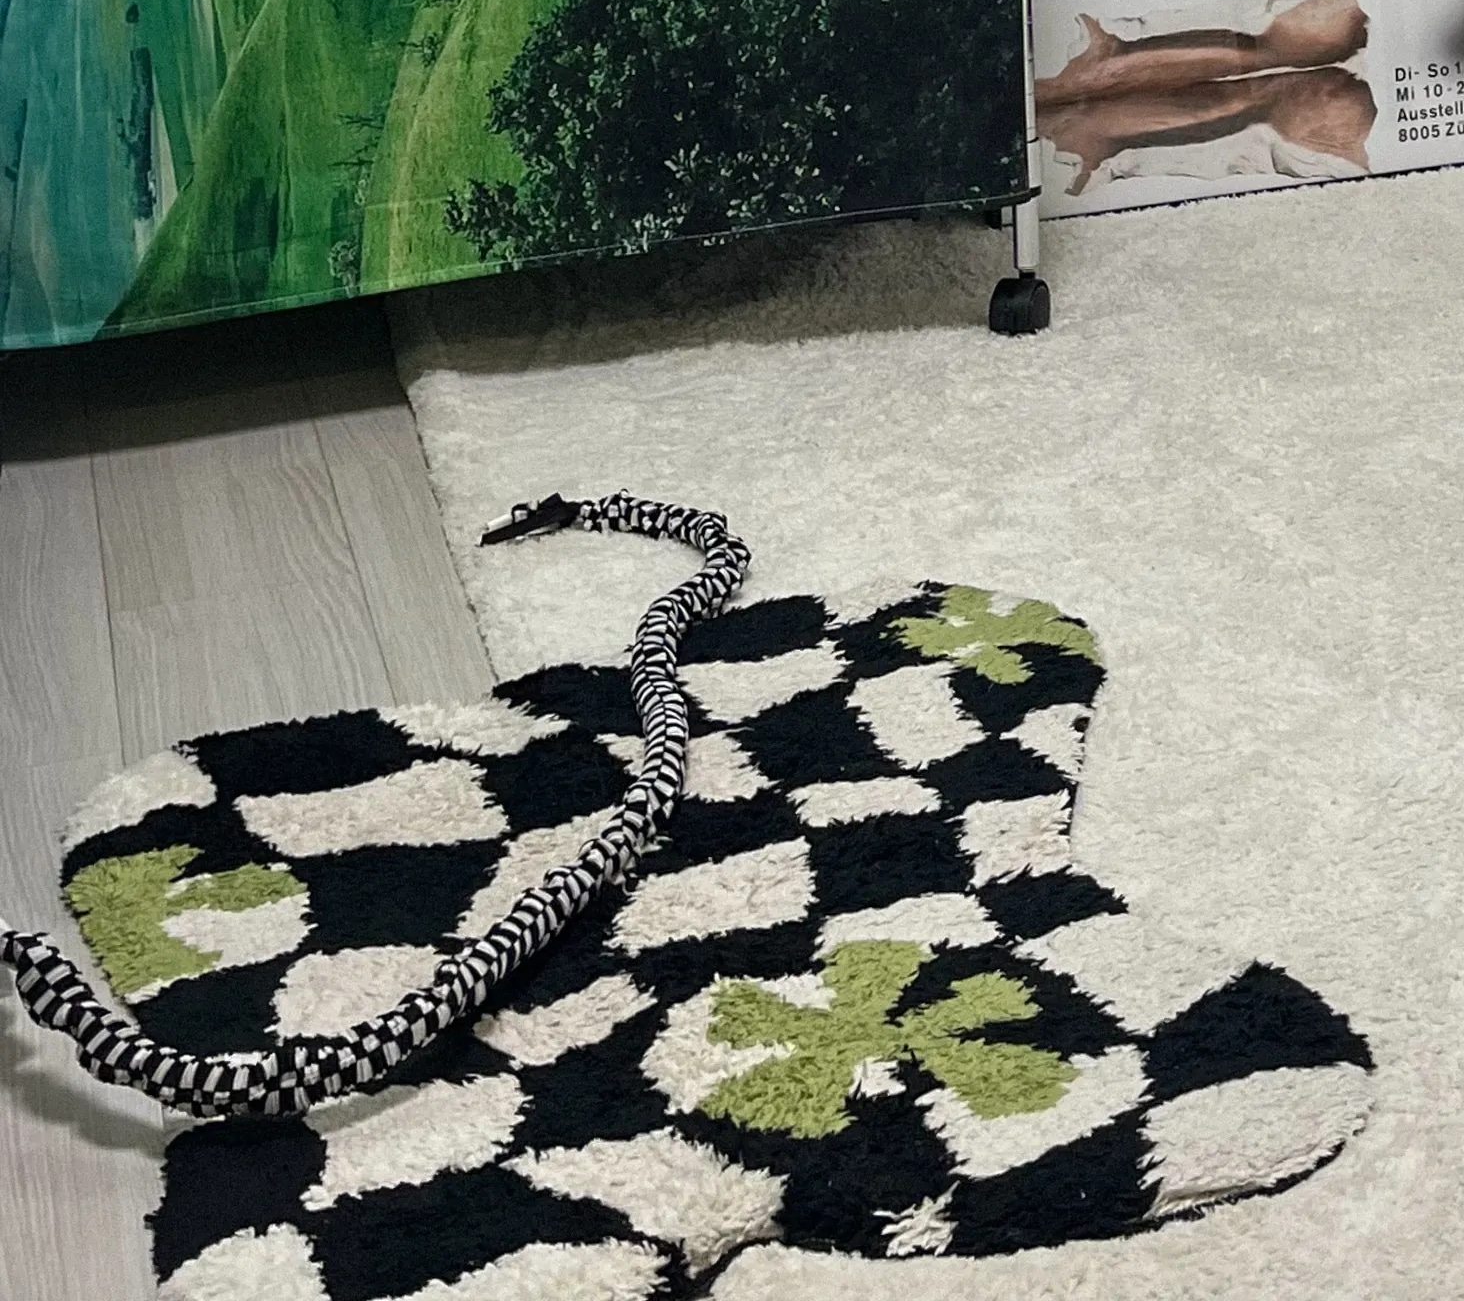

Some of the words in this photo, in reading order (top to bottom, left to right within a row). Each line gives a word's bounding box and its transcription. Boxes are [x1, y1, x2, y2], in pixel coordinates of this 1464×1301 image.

[1427, 63, 1449, 78] So
[1396, 85, 1415, 102] Mi
[1398, 124, 1441, 143] 8005
